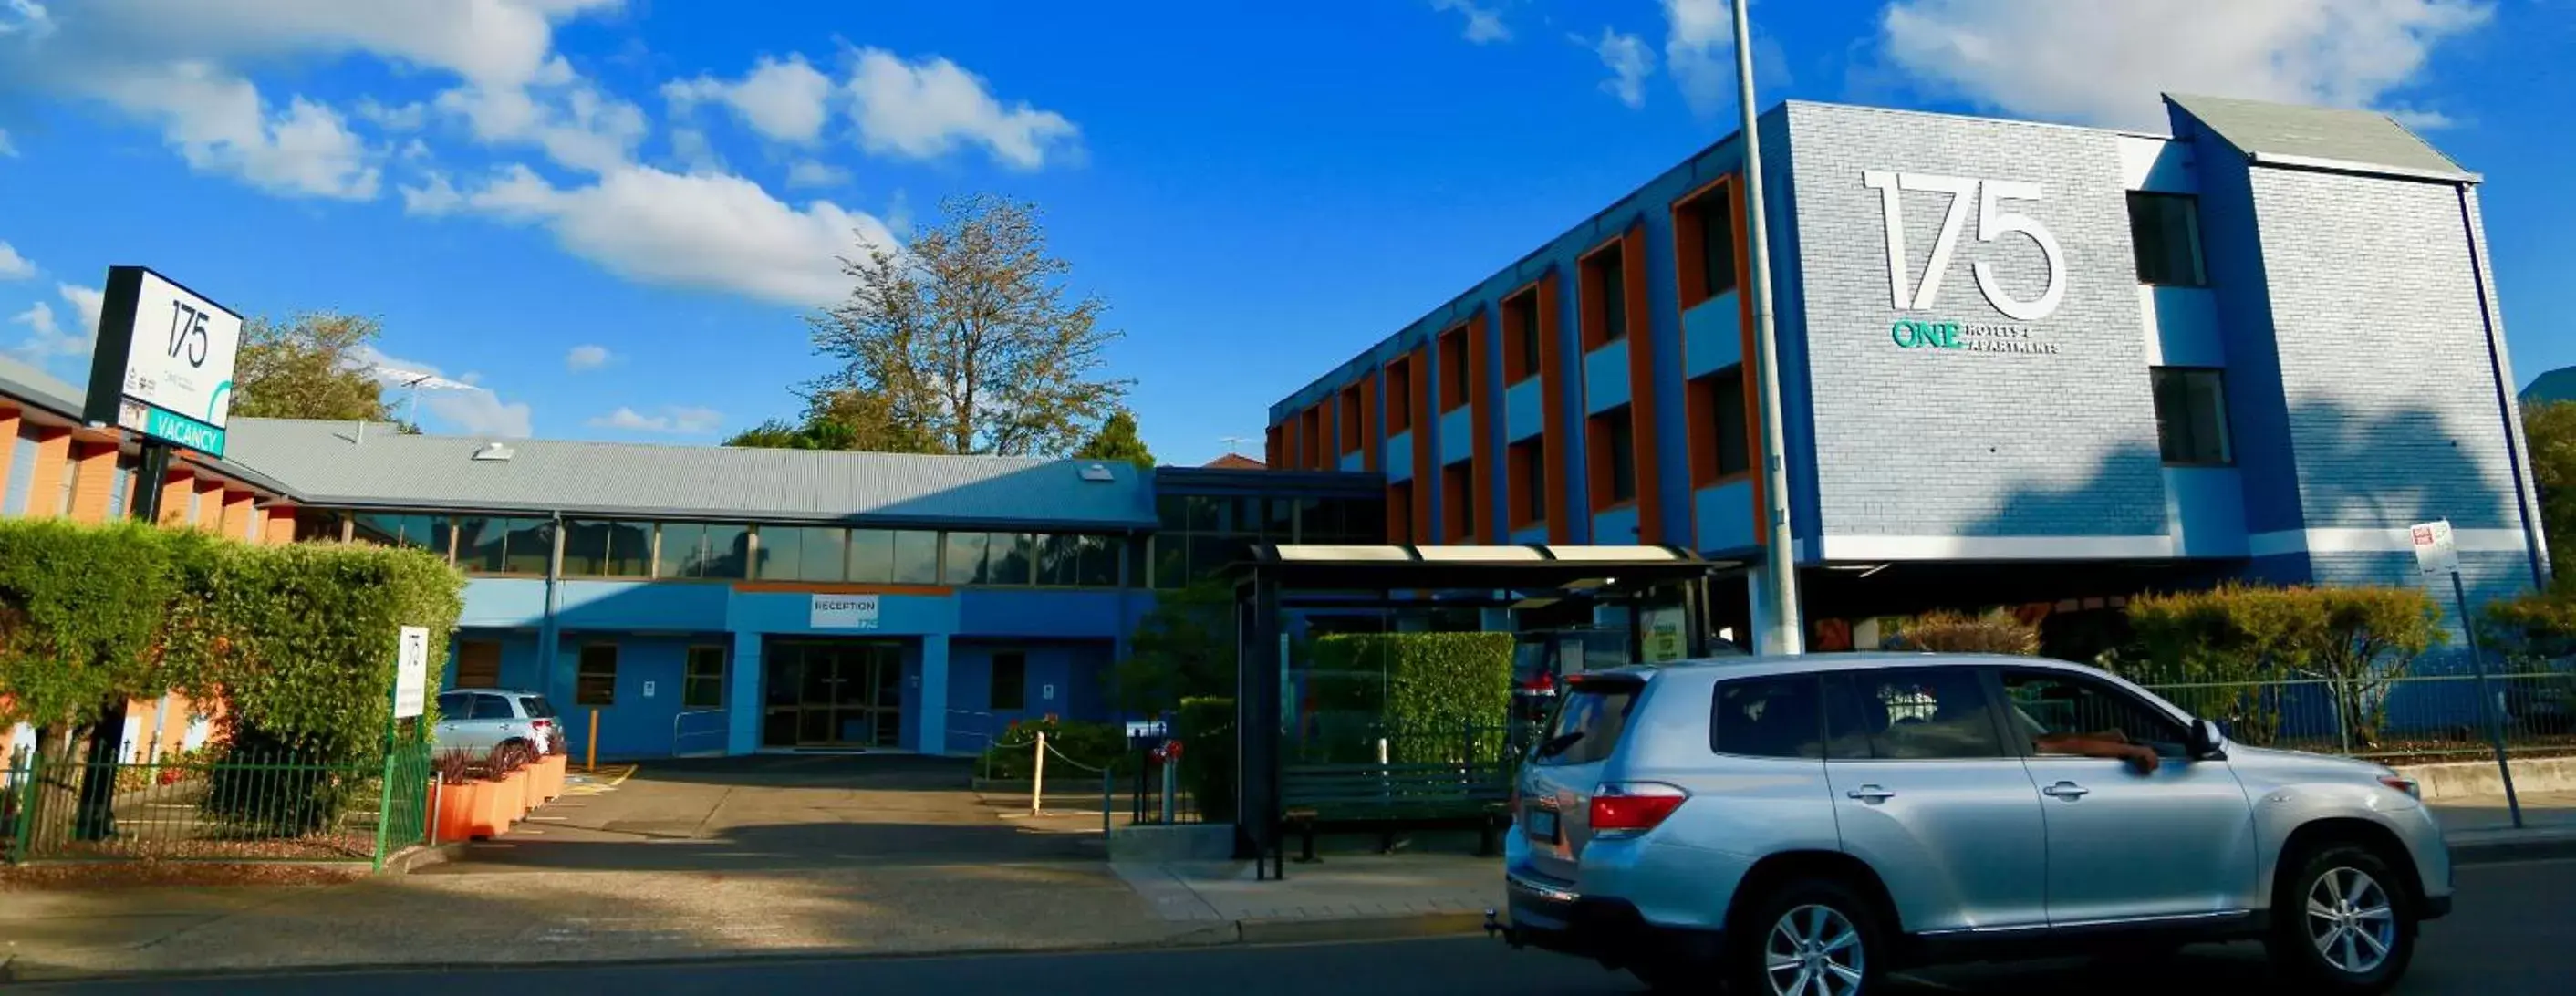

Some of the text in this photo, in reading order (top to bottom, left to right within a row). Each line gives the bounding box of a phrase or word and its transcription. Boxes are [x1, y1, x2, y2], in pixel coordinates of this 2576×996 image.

[1862, 171, 2066, 321] 175
[167, 299, 210, 368] 175
[1892, 319, 1961, 348] ONE
[1965, 323, 2018, 337] HOTELS
[1967, 339, 2061, 355] APARTMENTS
[157, 415, 218, 451] VACANCY
[815, 601, 875, 610] RECEPTION
